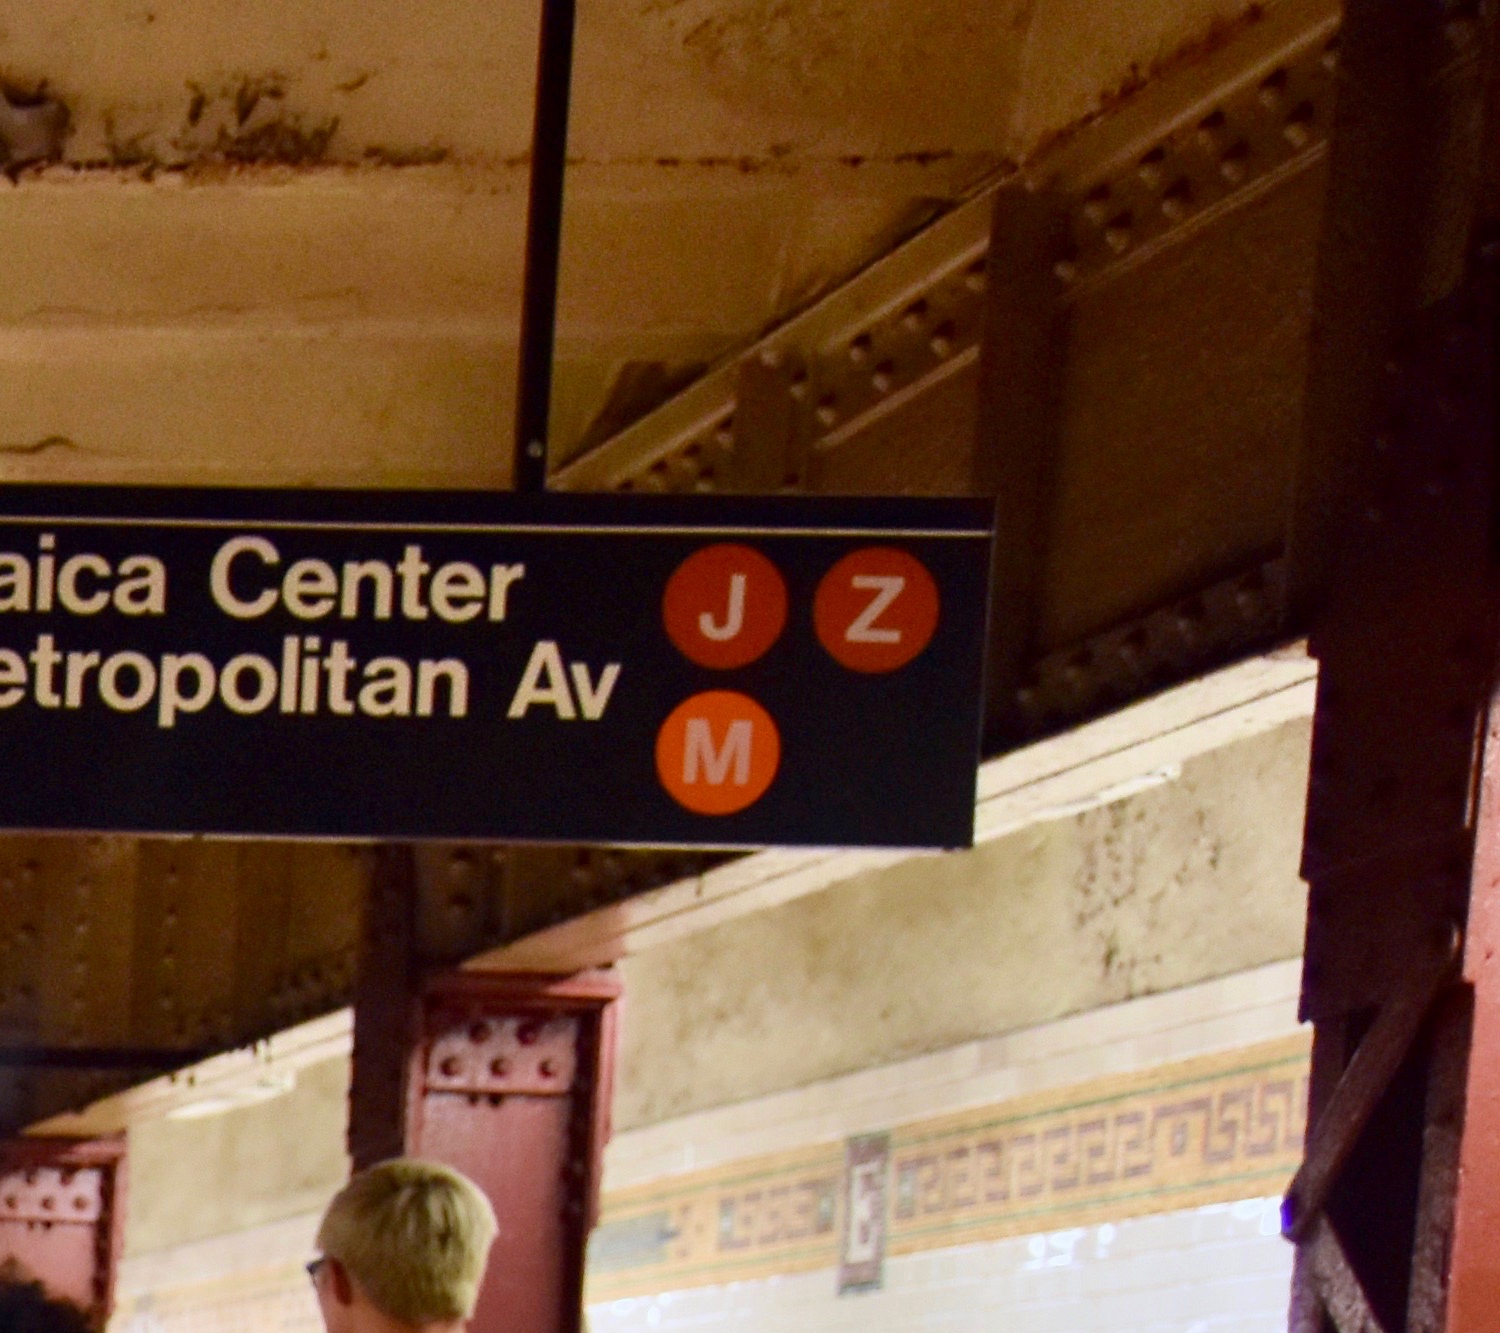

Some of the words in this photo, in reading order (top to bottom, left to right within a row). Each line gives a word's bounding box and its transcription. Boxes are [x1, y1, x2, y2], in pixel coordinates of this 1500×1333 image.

[210, 536, 525, 622] Center
[699, 573, 747, 641] J
[845, 575, 905, 643] Z
[507, 641, 621, 720] Av
[683, 717, 754, 786] M
